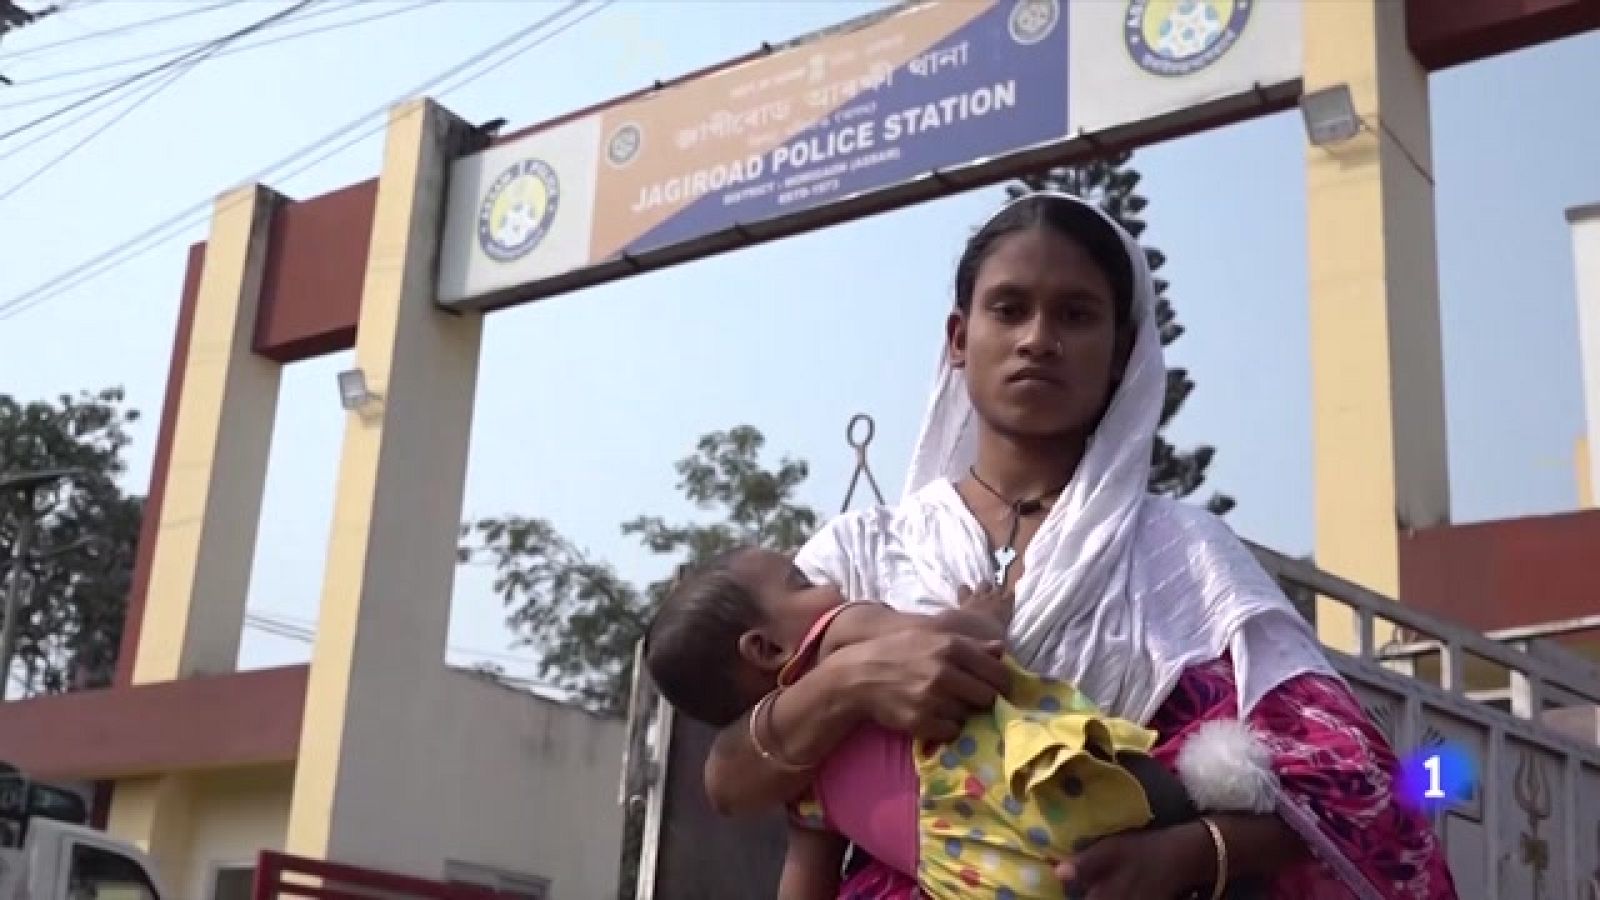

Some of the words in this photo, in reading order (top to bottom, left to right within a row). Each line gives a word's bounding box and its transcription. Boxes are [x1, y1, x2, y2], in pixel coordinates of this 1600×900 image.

[631, 154, 763, 212] JAGIROAD
[771, 122, 876, 174] POLICE
[883, 79, 1017, 142] STATION
